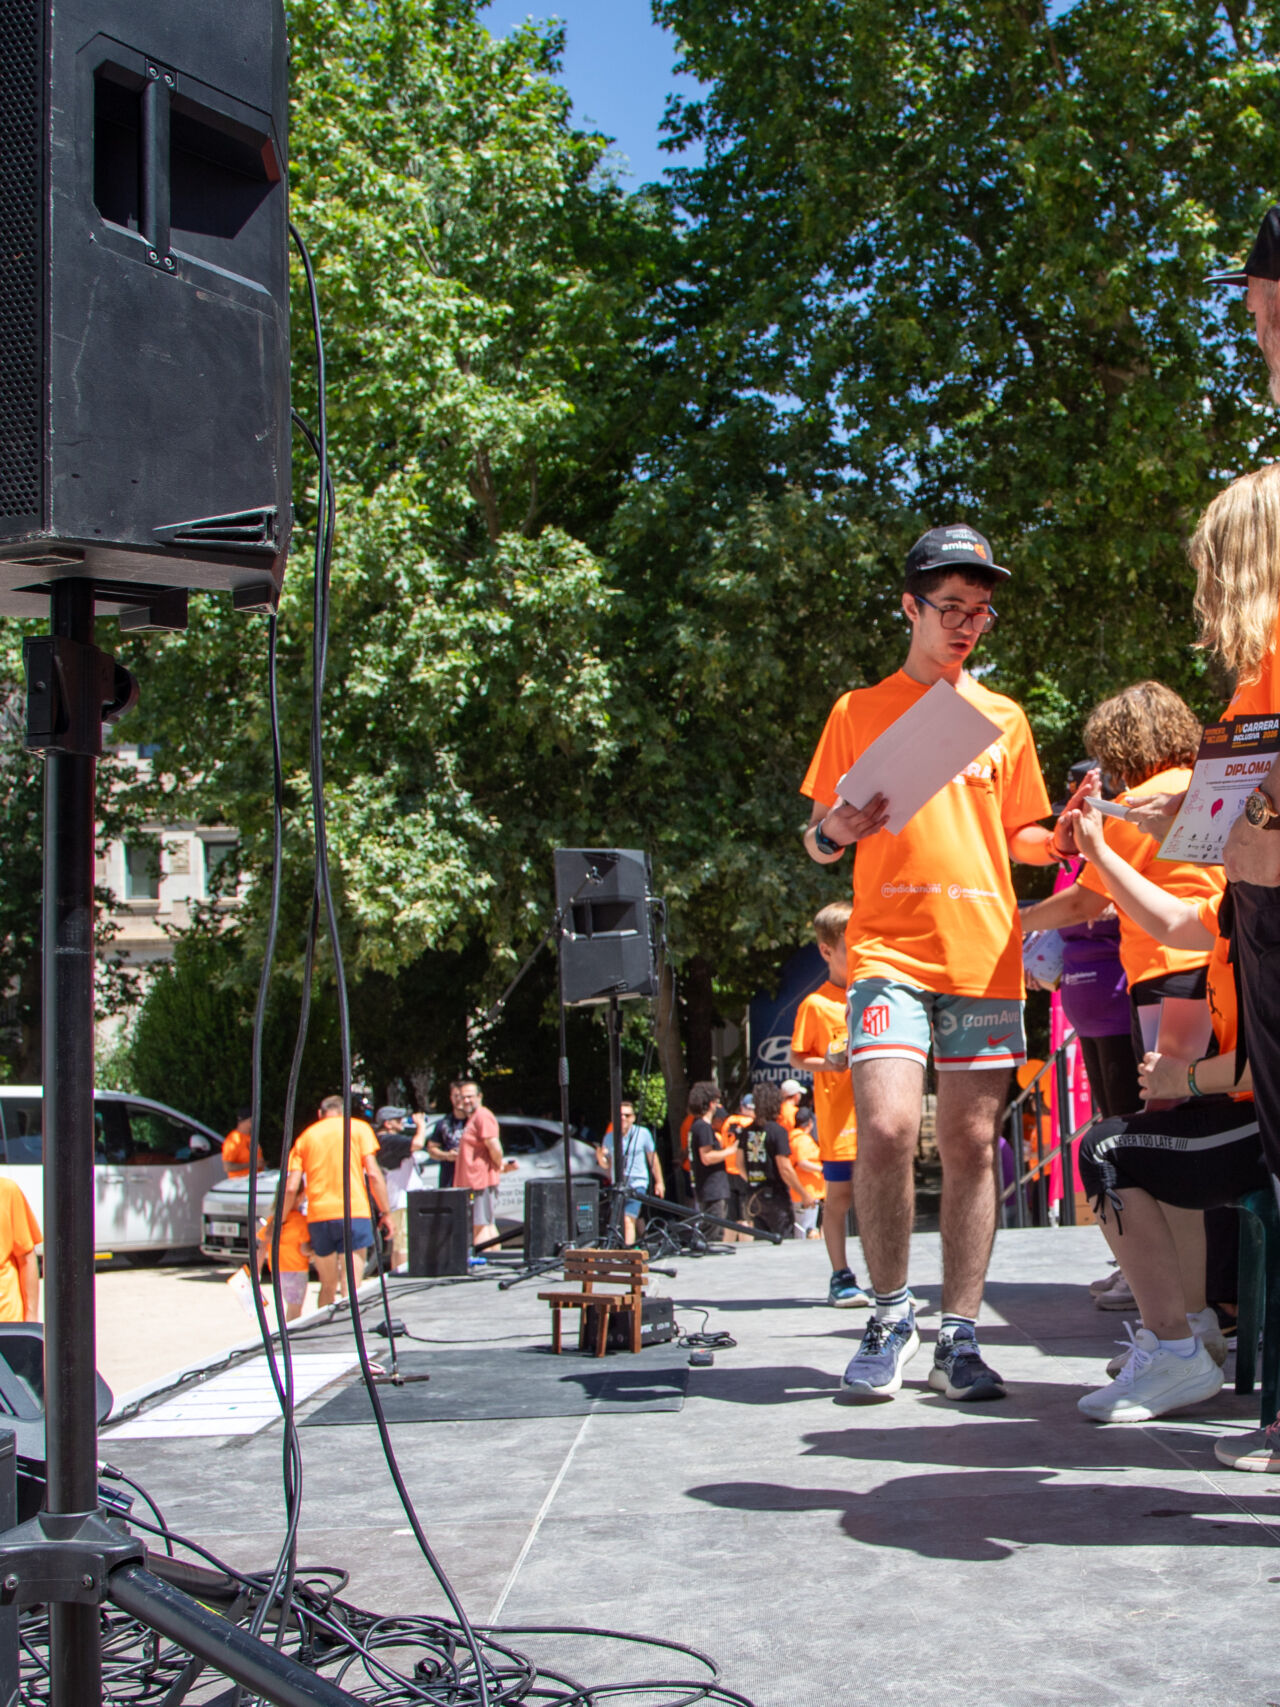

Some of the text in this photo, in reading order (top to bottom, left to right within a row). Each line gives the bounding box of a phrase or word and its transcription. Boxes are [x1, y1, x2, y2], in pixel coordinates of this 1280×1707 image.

[1242, 719, 1279, 733] CARRERA
[1233, 732, 1260, 742] INCLUSIVA
[1225, 761, 1271, 776] DIPLOMA
[751, 1067, 814, 1083] HYUNDA
[1139, 1135, 1154, 1147] TOO
[1154, 1135, 1173, 1149] LATE
